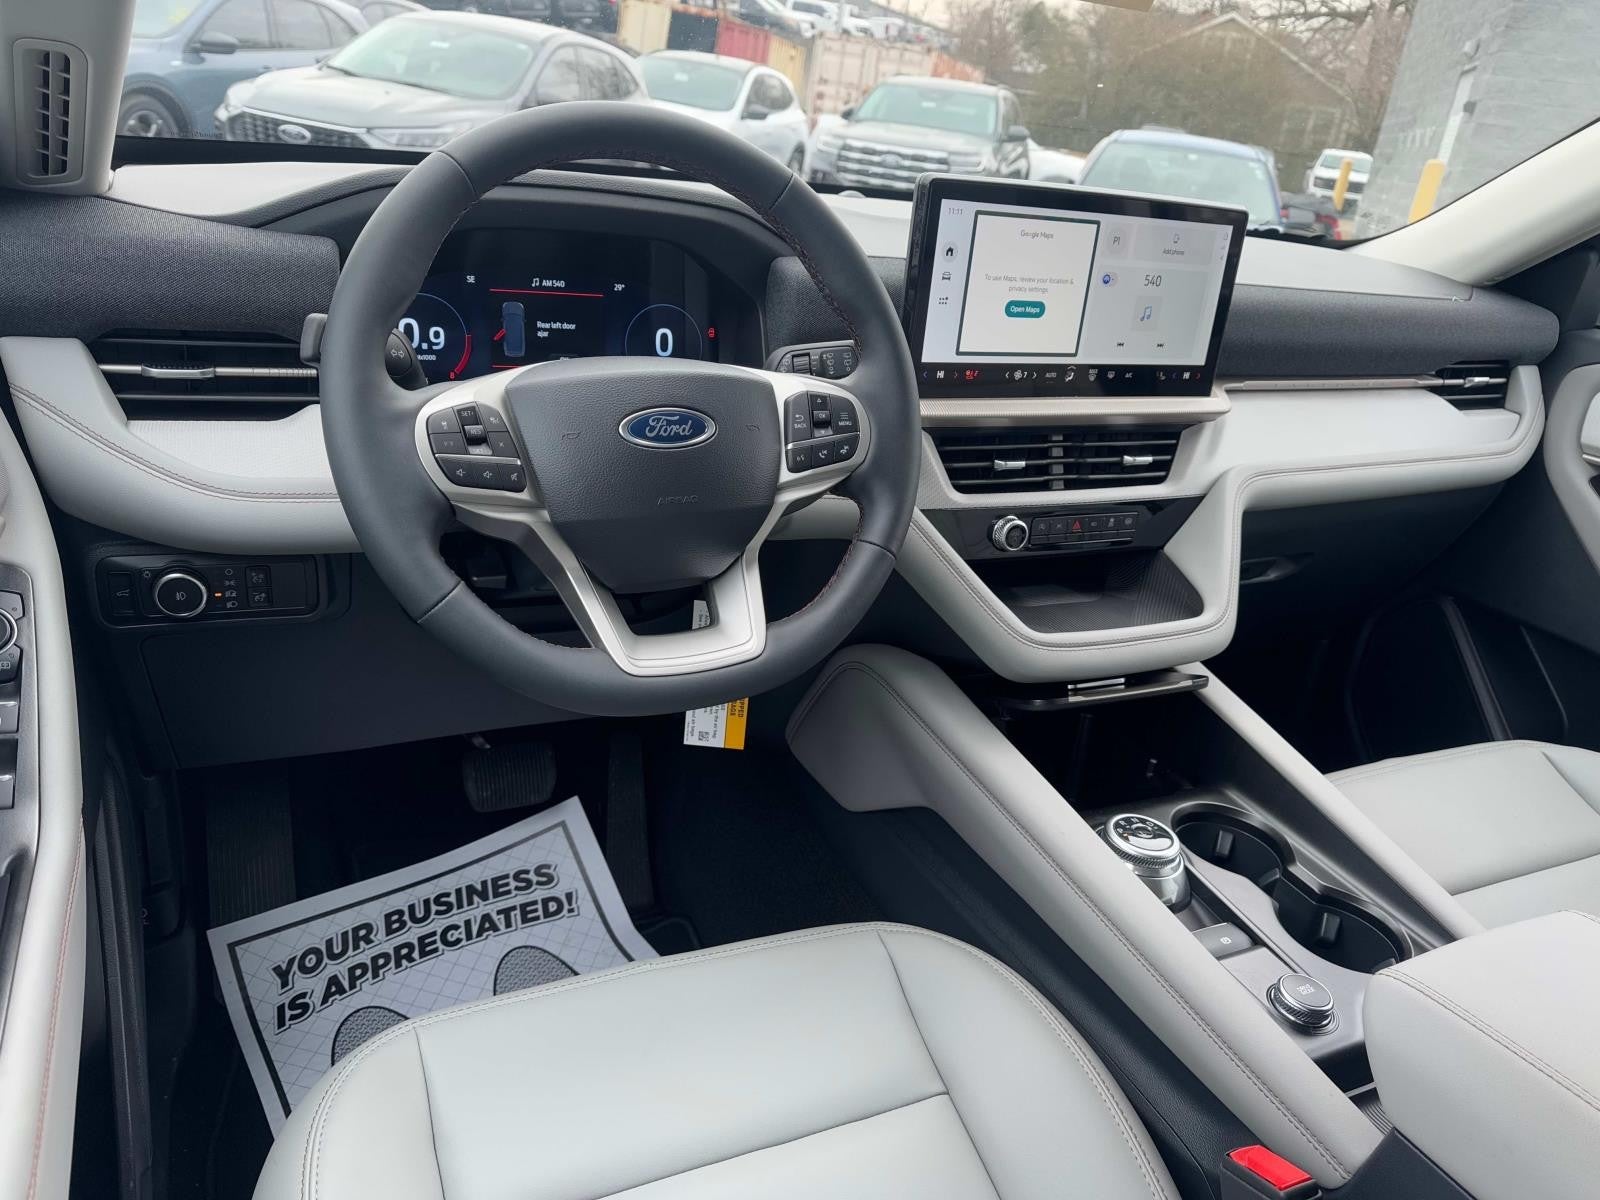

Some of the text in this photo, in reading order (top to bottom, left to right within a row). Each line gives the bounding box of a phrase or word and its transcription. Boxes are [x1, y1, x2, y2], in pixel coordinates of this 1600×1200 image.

[1020, 229, 1054, 240] Google Maps
[542, 279, 565, 288] AM 540
[1144, 274, 1162, 287] 540
[1010, 305, 1040, 314] Open Maps
[536, 320, 576, 330] Rear left door
[537, 330, 549, 338] ajar
[655, 327, 674, 357] 0
[936, 370, 945, 379] HI
[645, 415, 693, 438] Ford
[272, 863, 558, 991] YOUR BUSINESS
[274, 891, 579, 1033] IS APPRECIATED!
